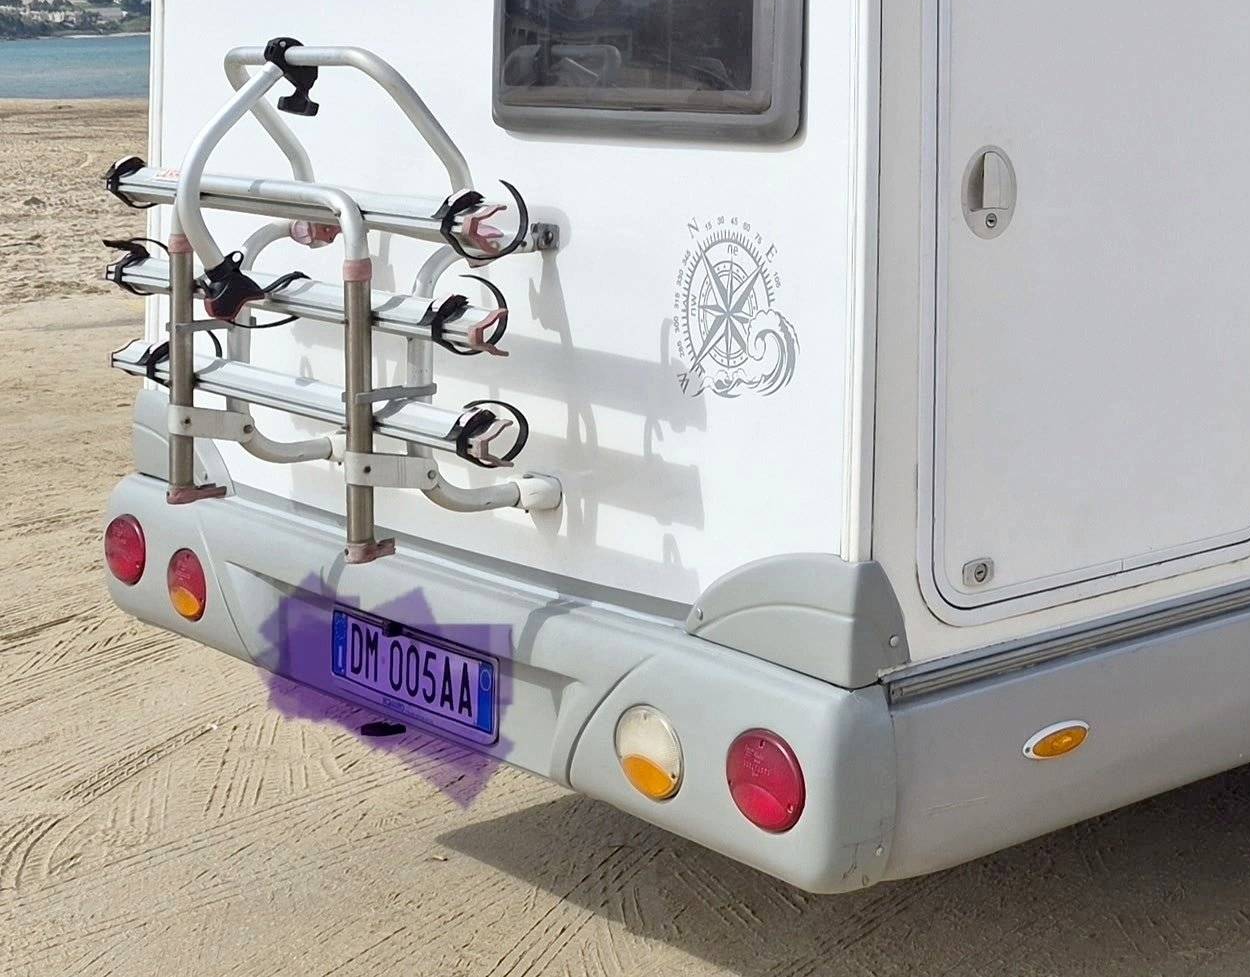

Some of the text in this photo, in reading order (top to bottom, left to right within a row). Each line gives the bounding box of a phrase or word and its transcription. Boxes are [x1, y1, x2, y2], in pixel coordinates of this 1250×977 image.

[687, 216, 700, 239] N
[765, 243, 778, 263] E
[350, 622, 379, 682] DM
[389, 640, 472, 717] 005AA
